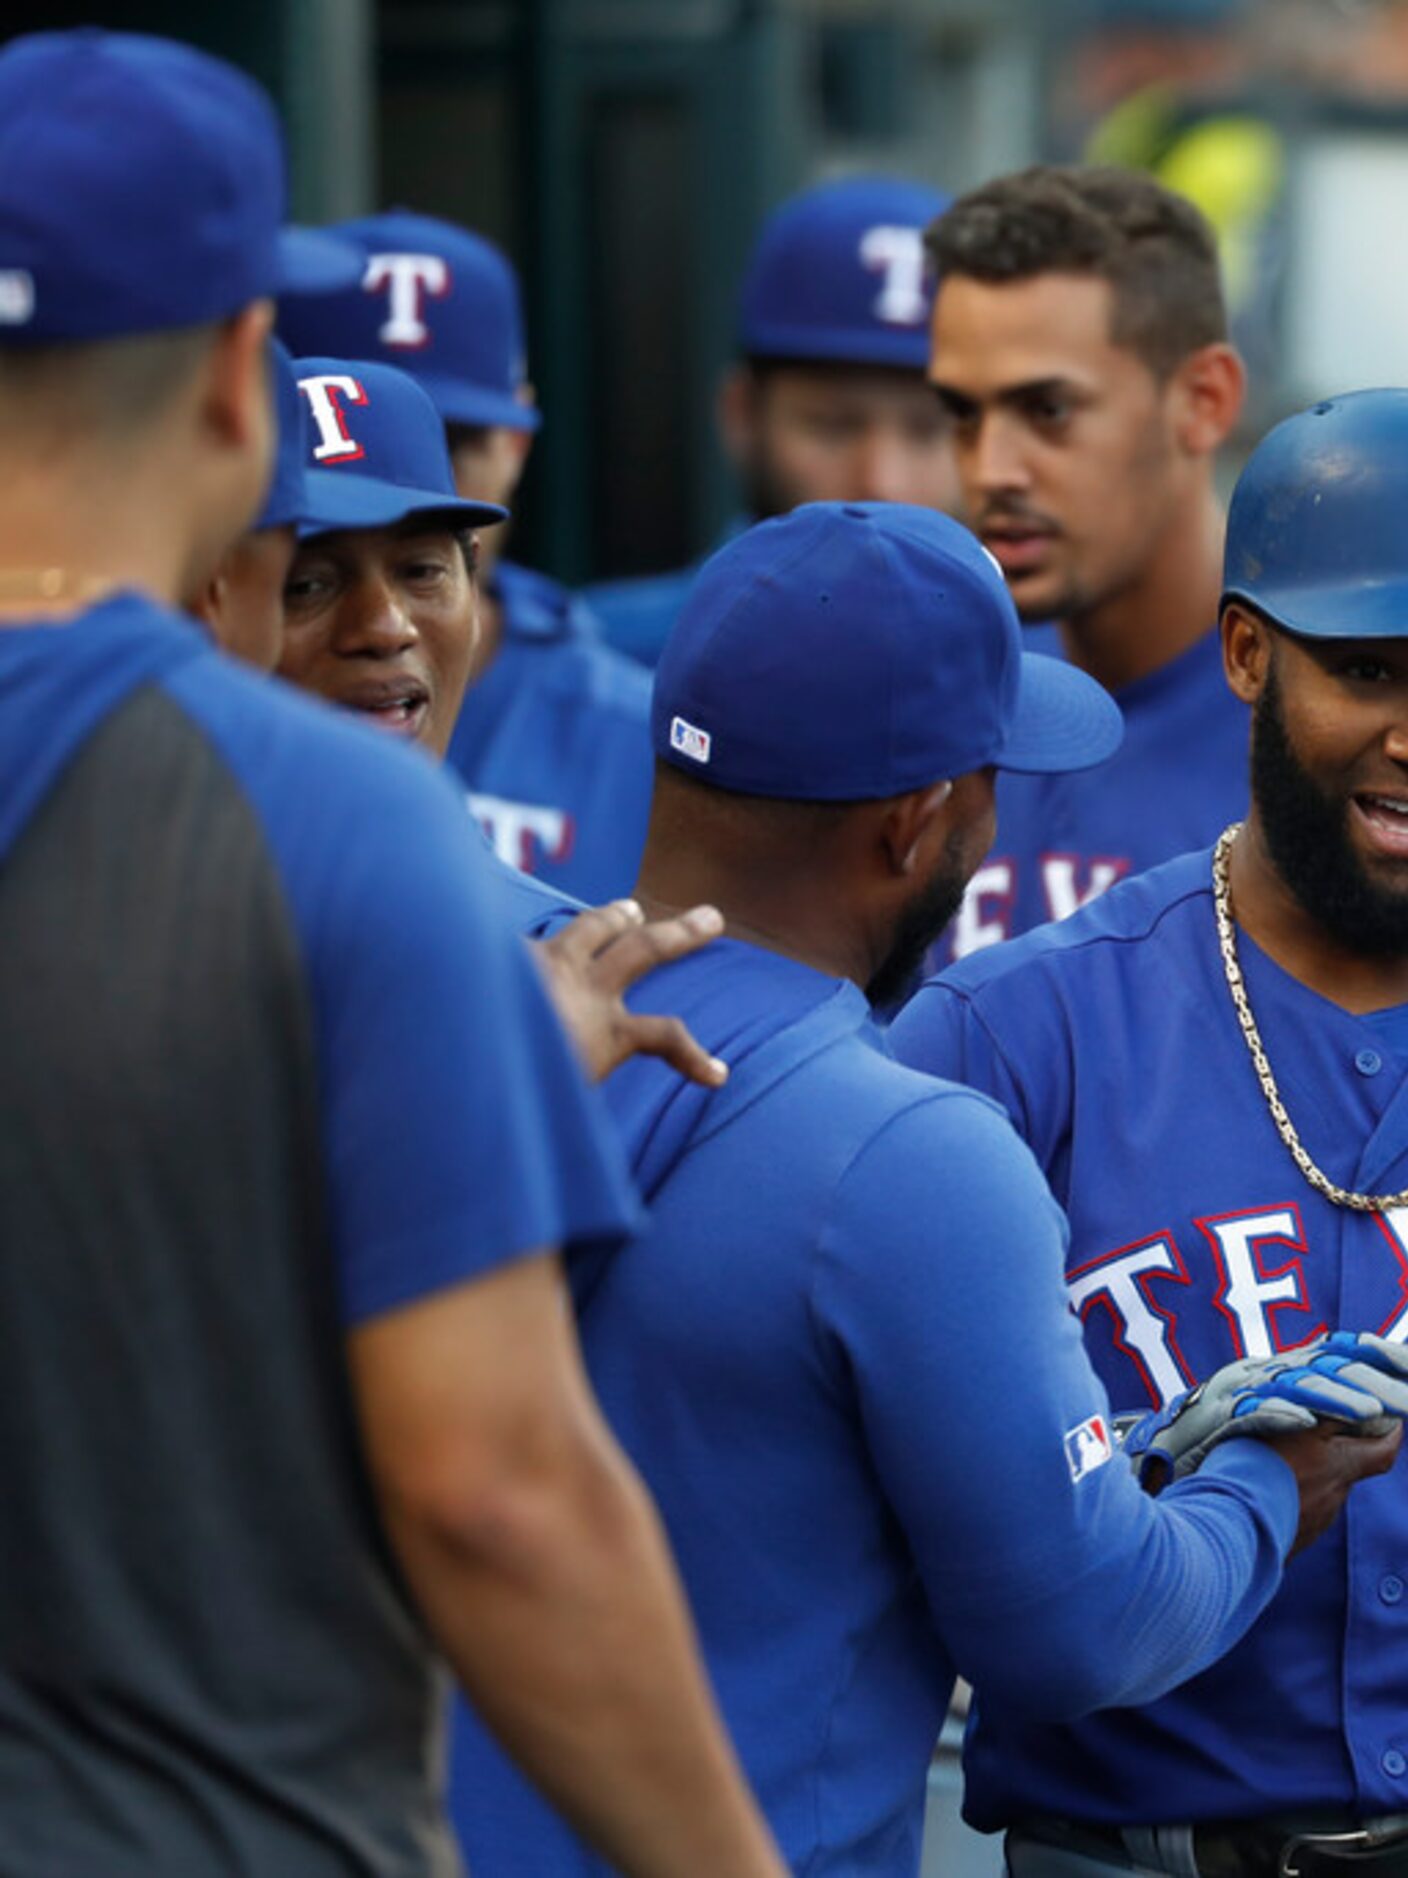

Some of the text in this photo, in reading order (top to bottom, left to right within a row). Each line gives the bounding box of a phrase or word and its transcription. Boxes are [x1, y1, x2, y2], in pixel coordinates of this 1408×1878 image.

[361, 252, 456, 354] T
[856, 225, 924, 332] T
[297, 375, 370, 466] T
[466, 793, 576, 875] T
